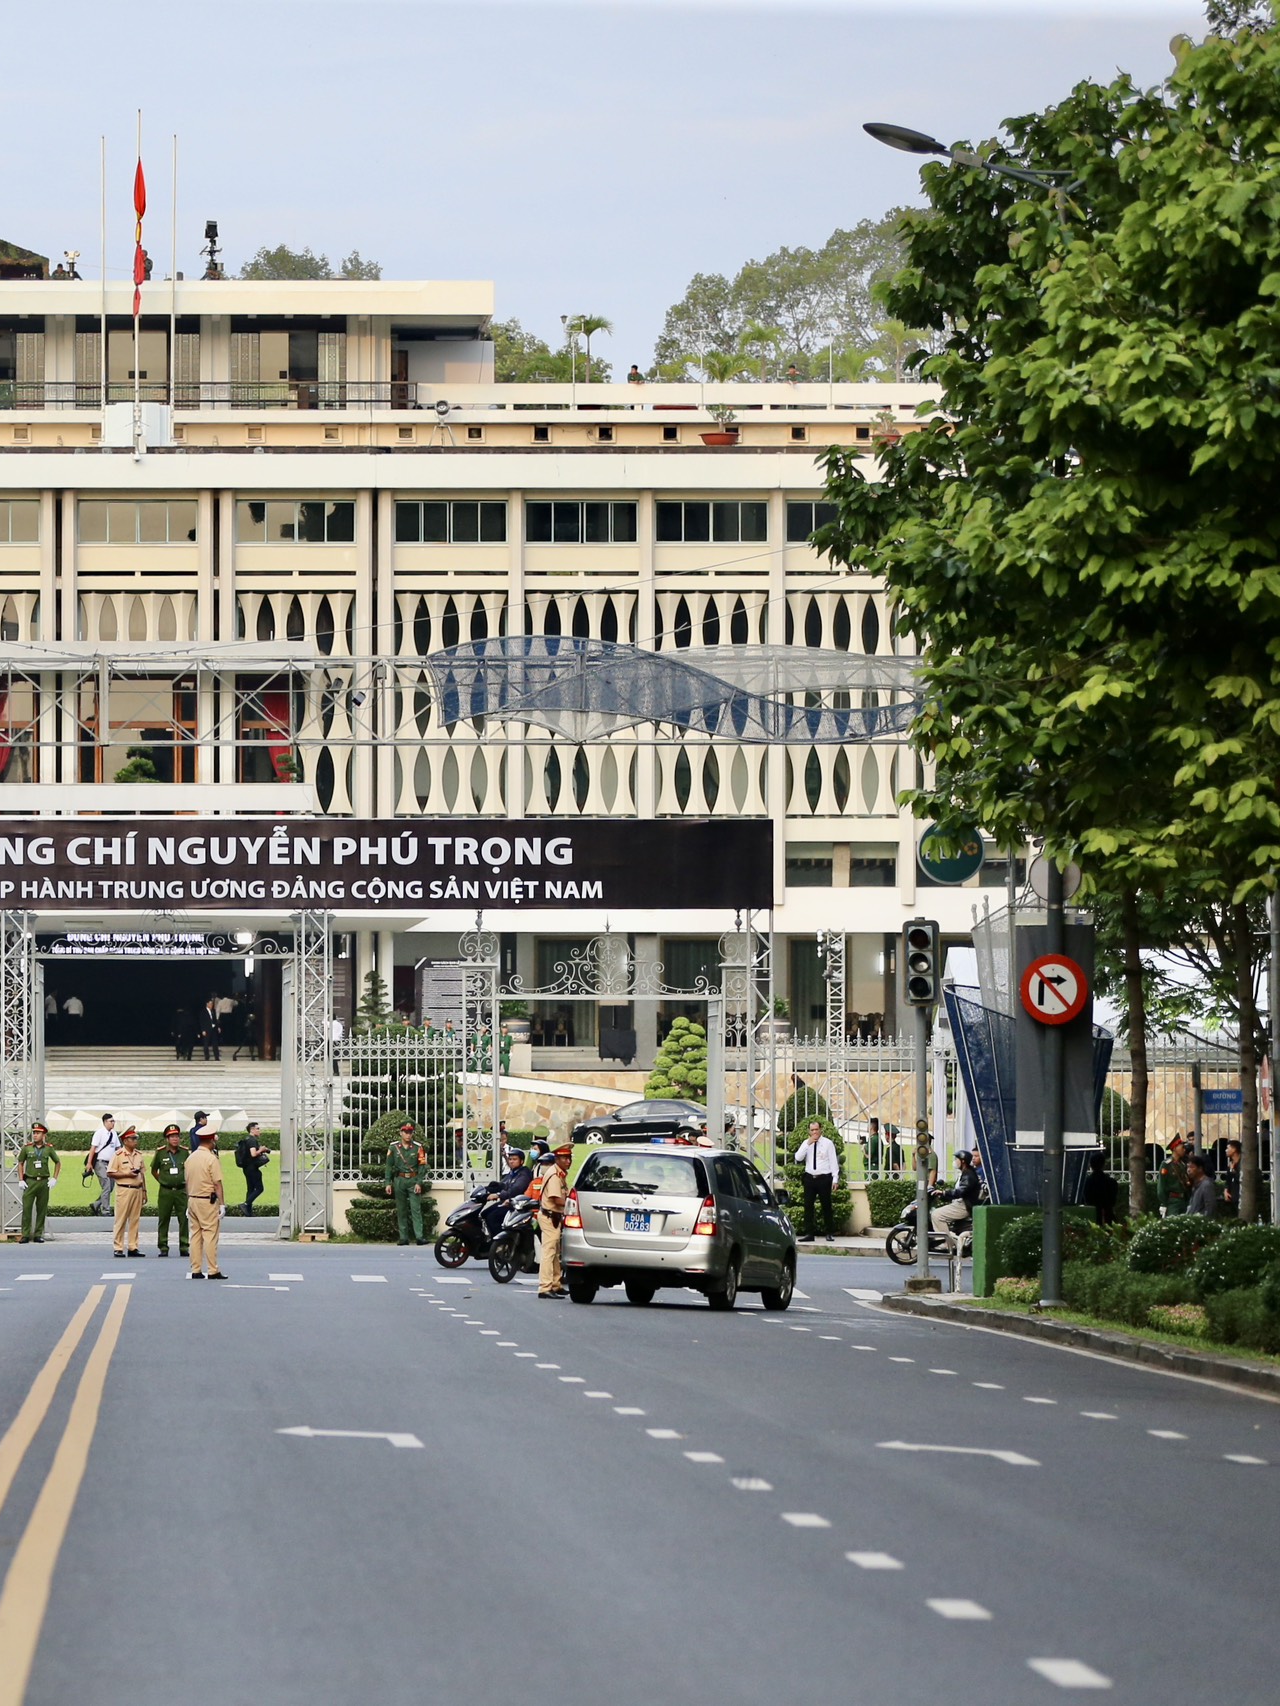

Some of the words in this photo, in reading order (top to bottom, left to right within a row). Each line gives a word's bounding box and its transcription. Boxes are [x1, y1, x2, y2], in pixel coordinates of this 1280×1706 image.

[67, 831, 138, 866] CHÍ
[148, 826, 321, 865] NGUYỄN
[334, 831, 418, 865] PHÚ
[428, 837, 573, 873] TRỌNG
[22, 877, 93, 899] HÀNH
[98, 881, 184, 899] TRUNG
[191, 878, 266, 899] ƯƠNG
[271, 875, 345, 899] ĐẢNG
[351, 877, 423, 904] CỘNG
[430, 875, 479, 899] SẢN
[485, 878, 540, 904] VIỆT
[546, 881, 603, 899] NAM
[630, 1213, 645, 1222] 50A
